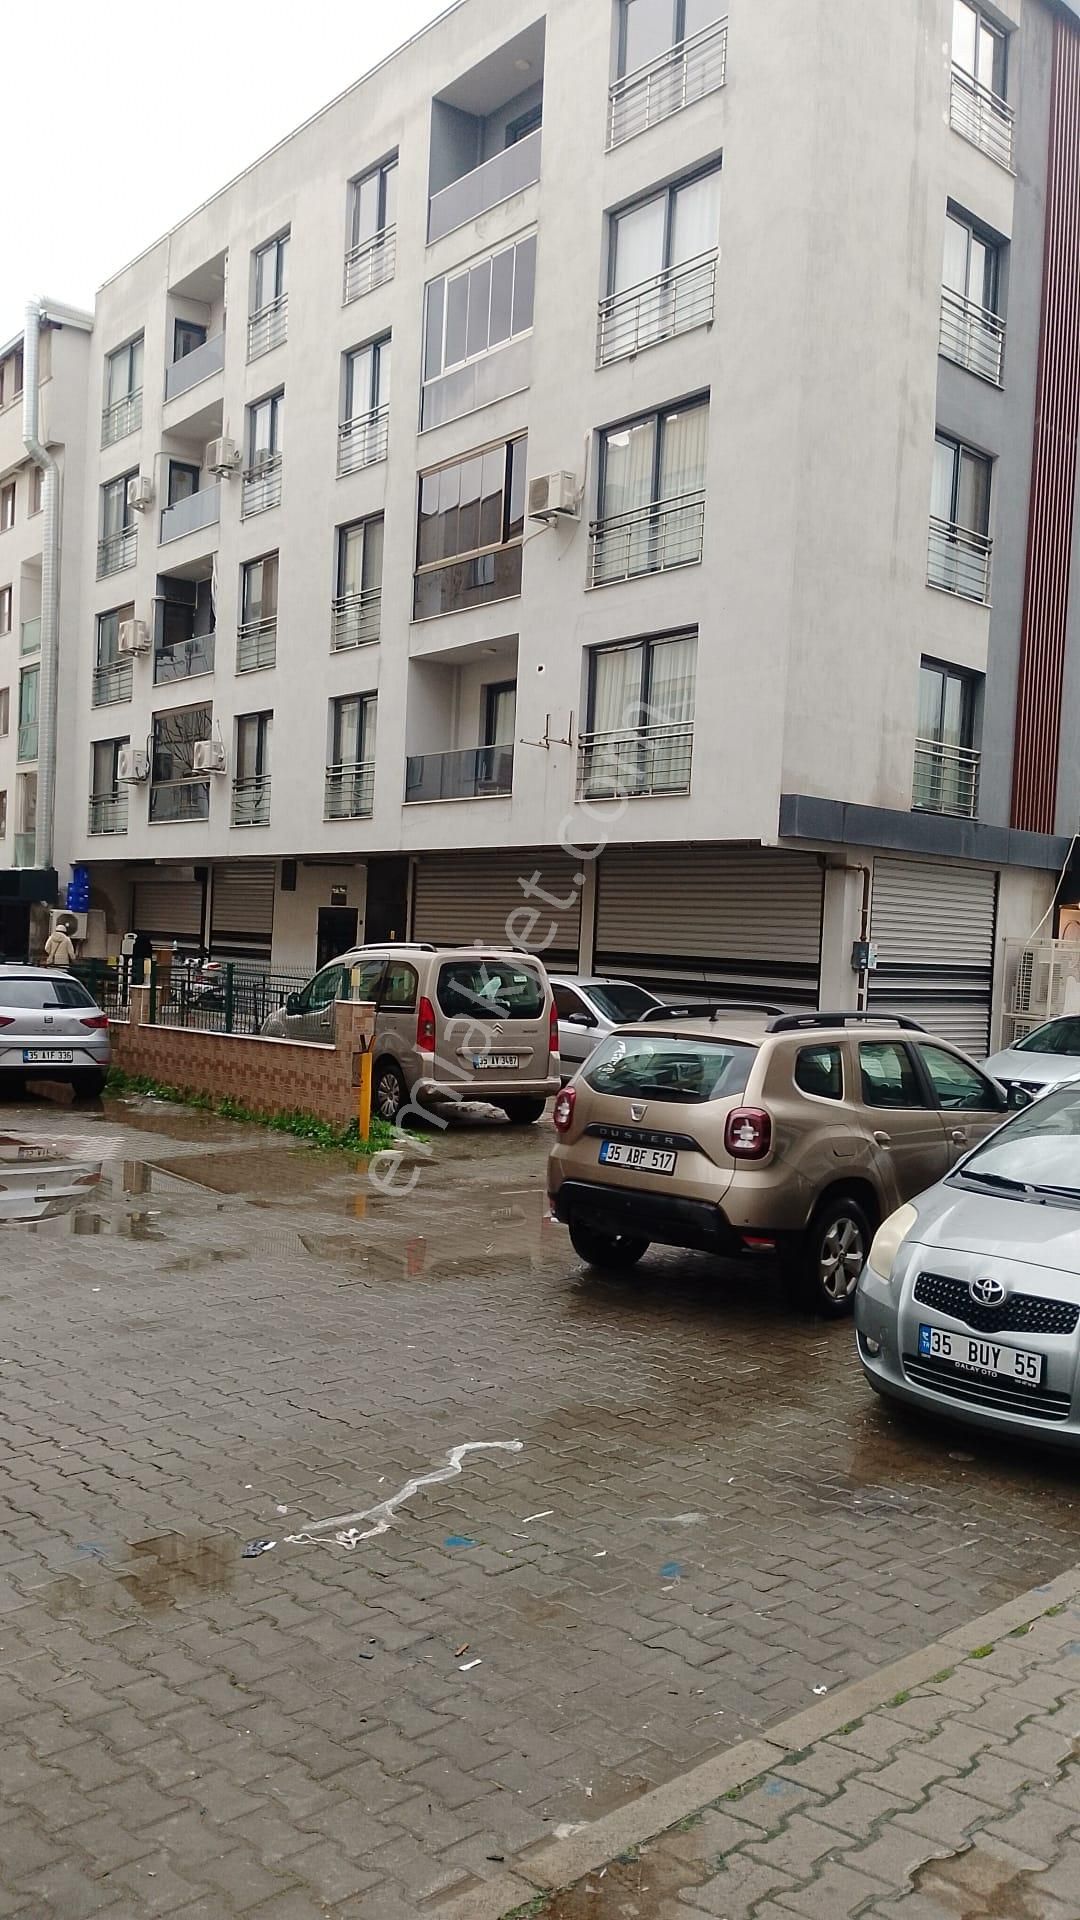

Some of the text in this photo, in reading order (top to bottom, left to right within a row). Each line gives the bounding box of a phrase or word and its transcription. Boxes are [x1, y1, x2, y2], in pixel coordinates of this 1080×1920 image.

[29, 1051, 38, 1059] 35
[600, 1128, 674, 1144] DUSTER
[607, 1145, 622, 1160] 35
[626, 1148, 648, 1164] ABF
[651, 1151, 673, 1169] 517
[931, 1332, 1037, 1379] 35 BUY 55
[981, 1368, 998, 1378] OTO
